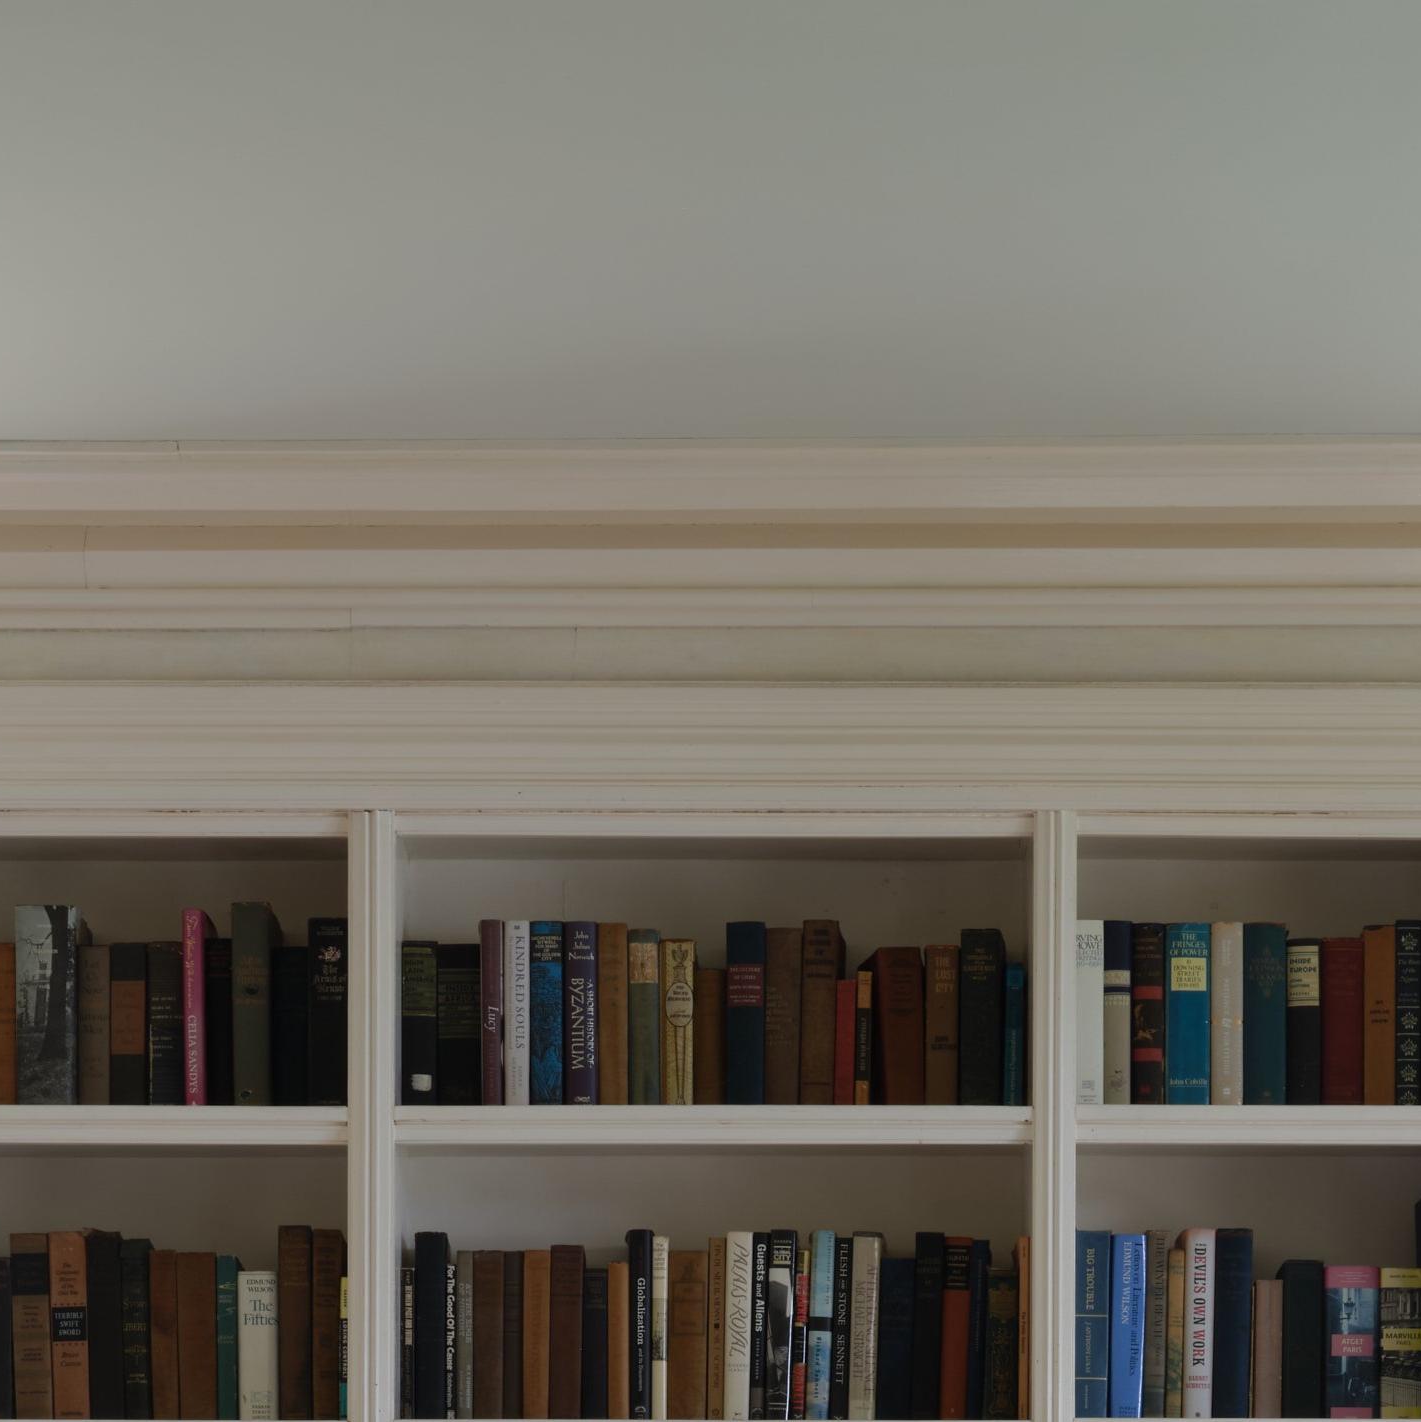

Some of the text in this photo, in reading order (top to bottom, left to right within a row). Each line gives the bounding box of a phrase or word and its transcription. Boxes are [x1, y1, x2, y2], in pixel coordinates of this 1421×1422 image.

[1171, 941, 1206, 949] FRINGES
[1180, 948, 1209, 956] POWER
[1181, 932, 1196, 940] THE
[514, 936, 526, 1049] KINDRED SOULS
[187, 1014, 197, 1046] CELIA
[484, 1005, 499, 1033] Lucy
[569, 977, 584, 1071] BYZANTIUM
[187, 1049, 198, 1094] SANDYS
[754, 1243, 767, 1332] Guests and Aliens
[1084, 1248, 1095, 1311] BIG TROUBLE
[1121, 1241, 1132, 1326] EDMUND WILSON
[243, 1313, 279, 1327] Fifties
[249, 1299, 274, 1313] The
[636, 1277, 646, 1345] Globalization
[1191, 1247, 1207, 1366] DEVIL'S OWN WORK
[1384, 1332, 1421, 1340] MARVILLE
